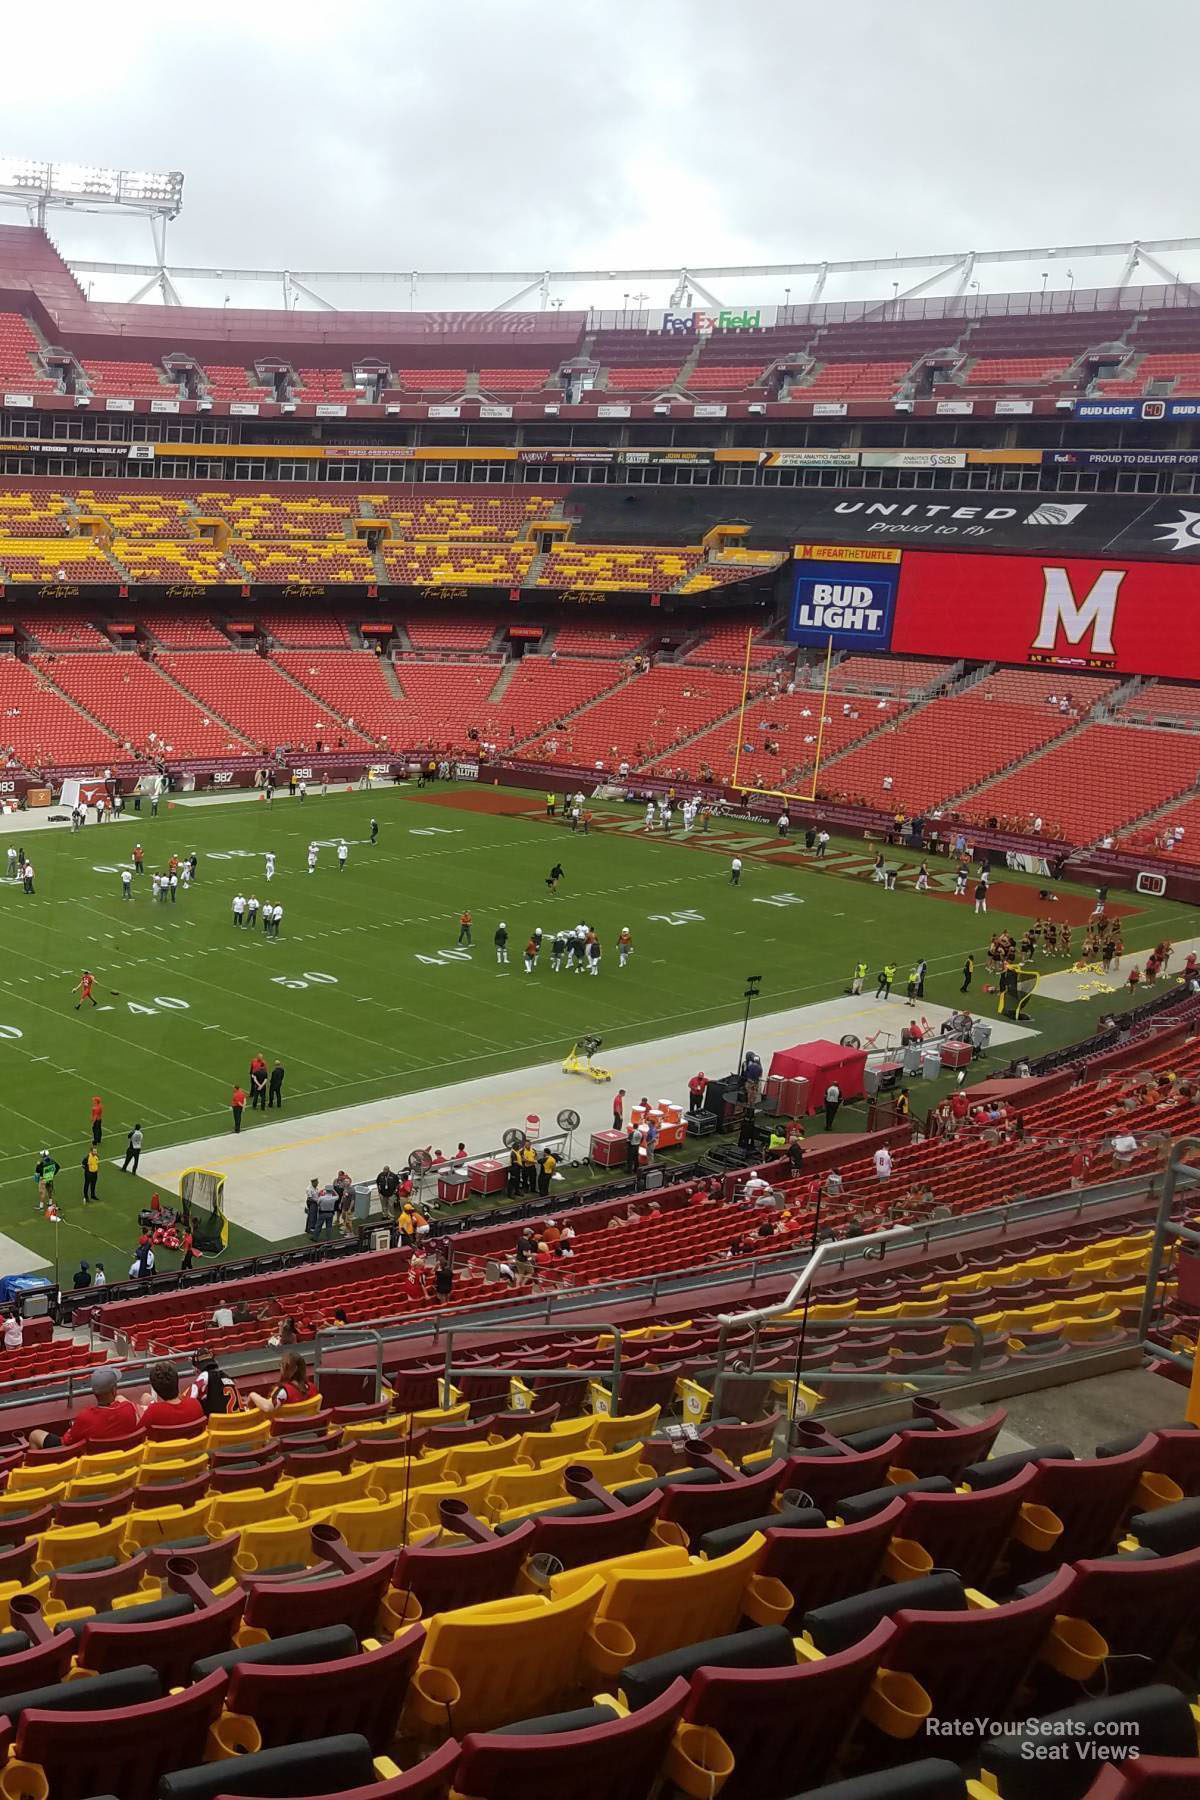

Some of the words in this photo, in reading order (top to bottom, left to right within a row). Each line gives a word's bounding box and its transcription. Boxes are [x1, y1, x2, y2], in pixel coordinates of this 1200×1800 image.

[662, 310, 760, 330] FedExField
[1079, 406, 1103, 416] BUD
[1103, 406, 1135, 415] LIGHT
[1146, 404, 1161, 416] 40
[1172, 405, 1196, 415] BUD
[0, 444, 30, 452] DOWNLOAD
[73, 446, 96, 454] OFFICIAL
[938, 456, 957, 465] sas
[1089, 454, 1122, 463] PROUD
[1122, 455, 1136, 464] TO
[1137, 455, 1177, 464] DELIVER
[1178, 455, 1198, 463] FOR
[833, 502, 1018, 520] UNITED
[866, 521, 933, 536] Proud
[936, 523, 959, 536] to
[961, 523, 995, 537] fly
[816, 547, 893, 560] #FEARTHETURTLE
[812, 584, 873, 608] BUD
[798, 604, 883, 631] LIGHT
[1029, 565, 1129, 655] M
[1142, 878, 1161, 892] 40
[647, 909, 706, 926] 20
[413, 946, 474, 967] 40
[270, 971, 339, 990] 50
[127, 995, 191, 1016] 40
[675, 1127, 684, 1140] G
